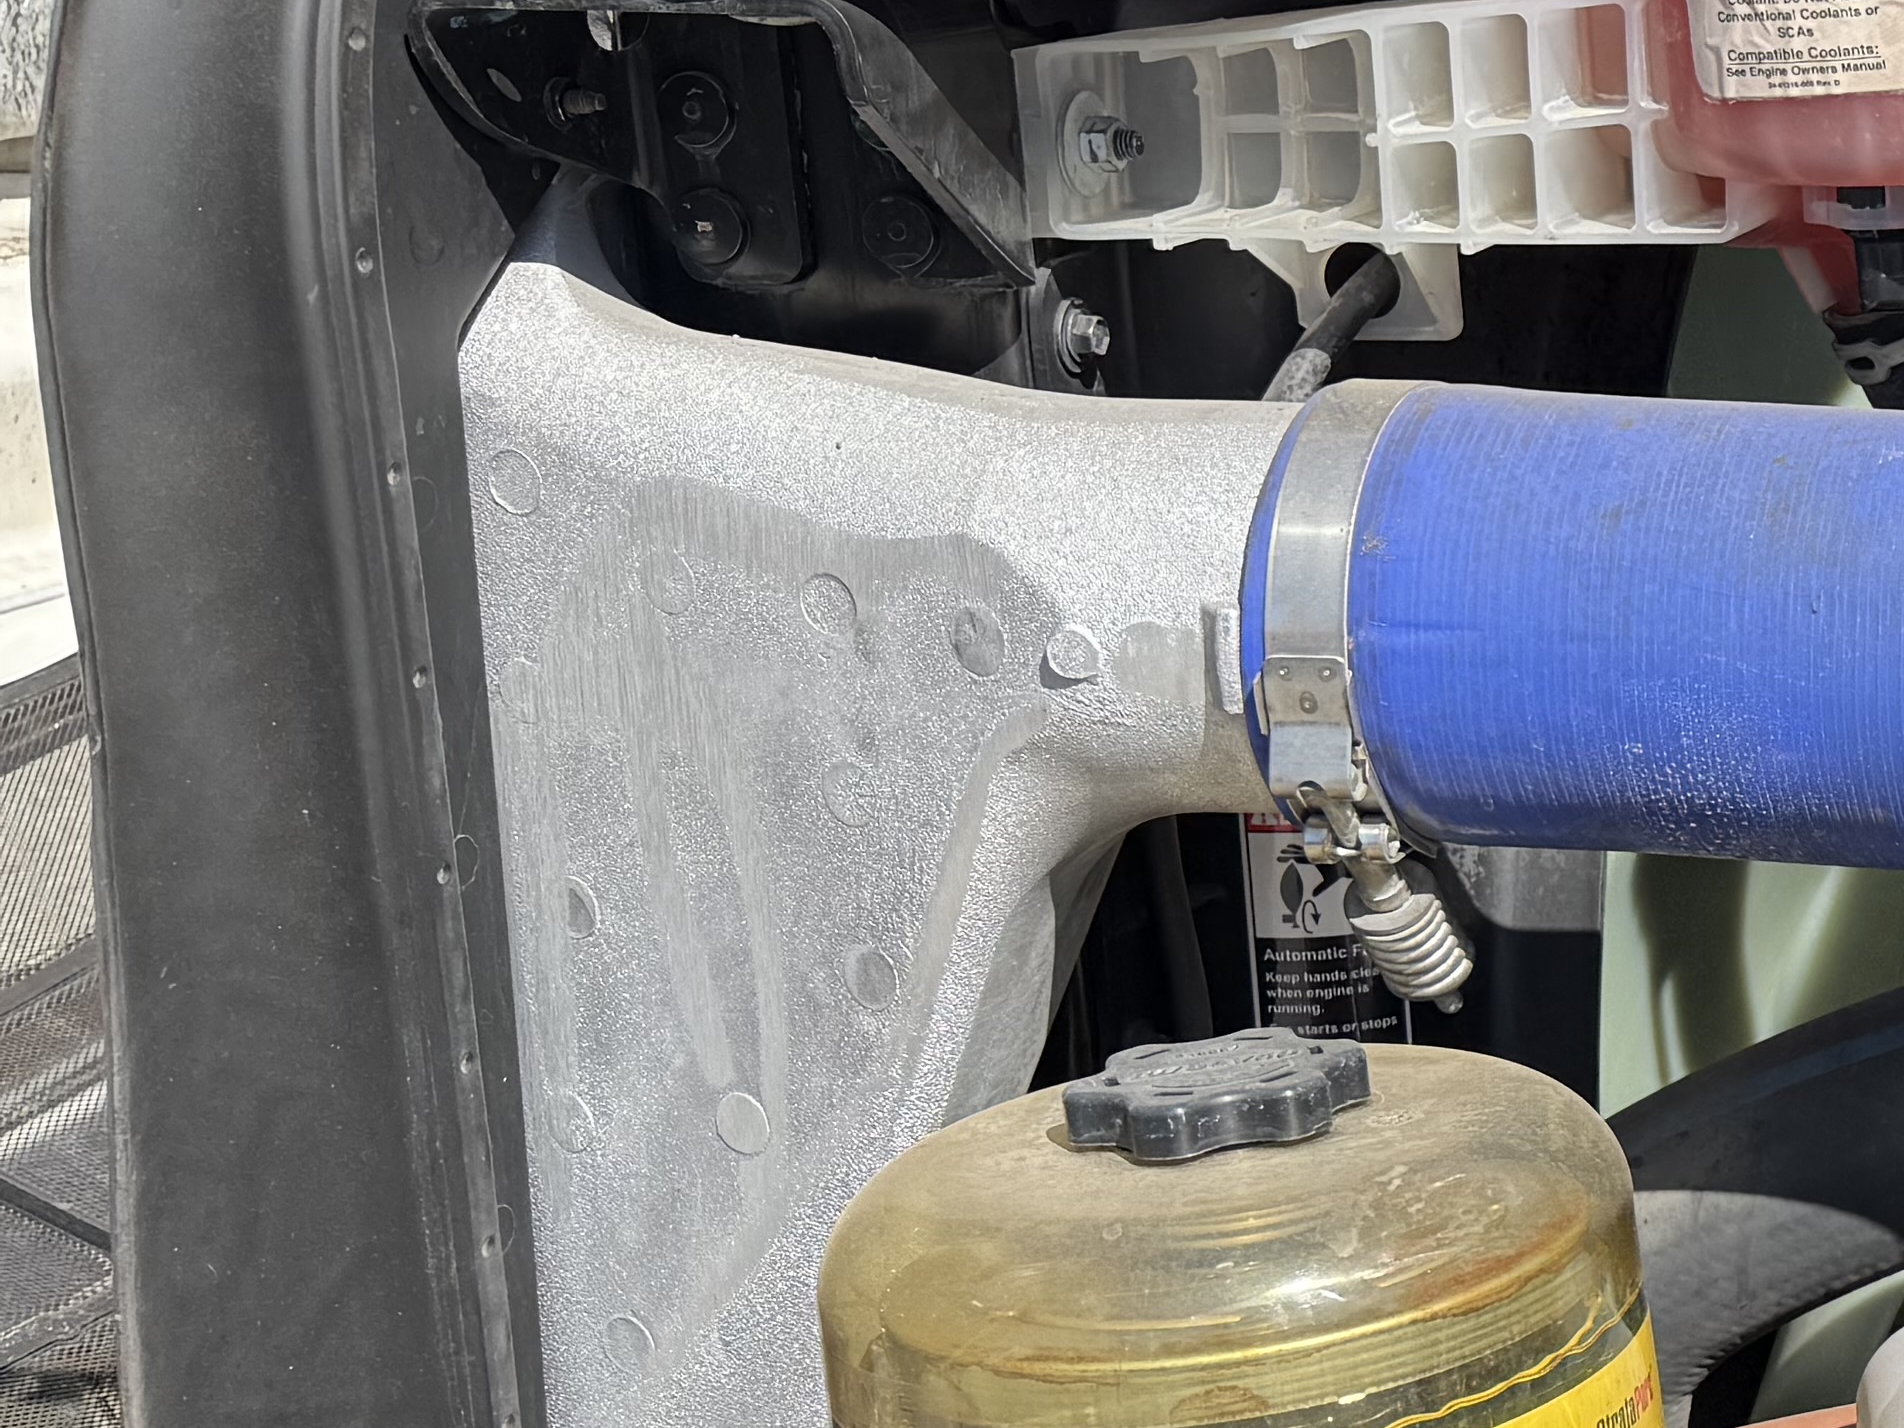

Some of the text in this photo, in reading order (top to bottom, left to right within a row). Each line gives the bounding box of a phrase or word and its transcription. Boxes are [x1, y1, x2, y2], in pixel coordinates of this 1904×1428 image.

[1717, 5, 1880, 23] Conventional Coolants or
[1777, 26, 1814, 40] SCAs
[1727, 44, 1880, 64] Compatible Coolants:
[1726, 60, 1887, 79] See Engine Owners Manual
[1264, 946, 1348, 962] Automatic
[1265, 969, 1348, 984] Keep hands
[1266, 983, 1370, 1000] when engine is
[1267, 1002, 1325, 1016] running.
[1297, 1015, 1398, 1036] starts or stops
